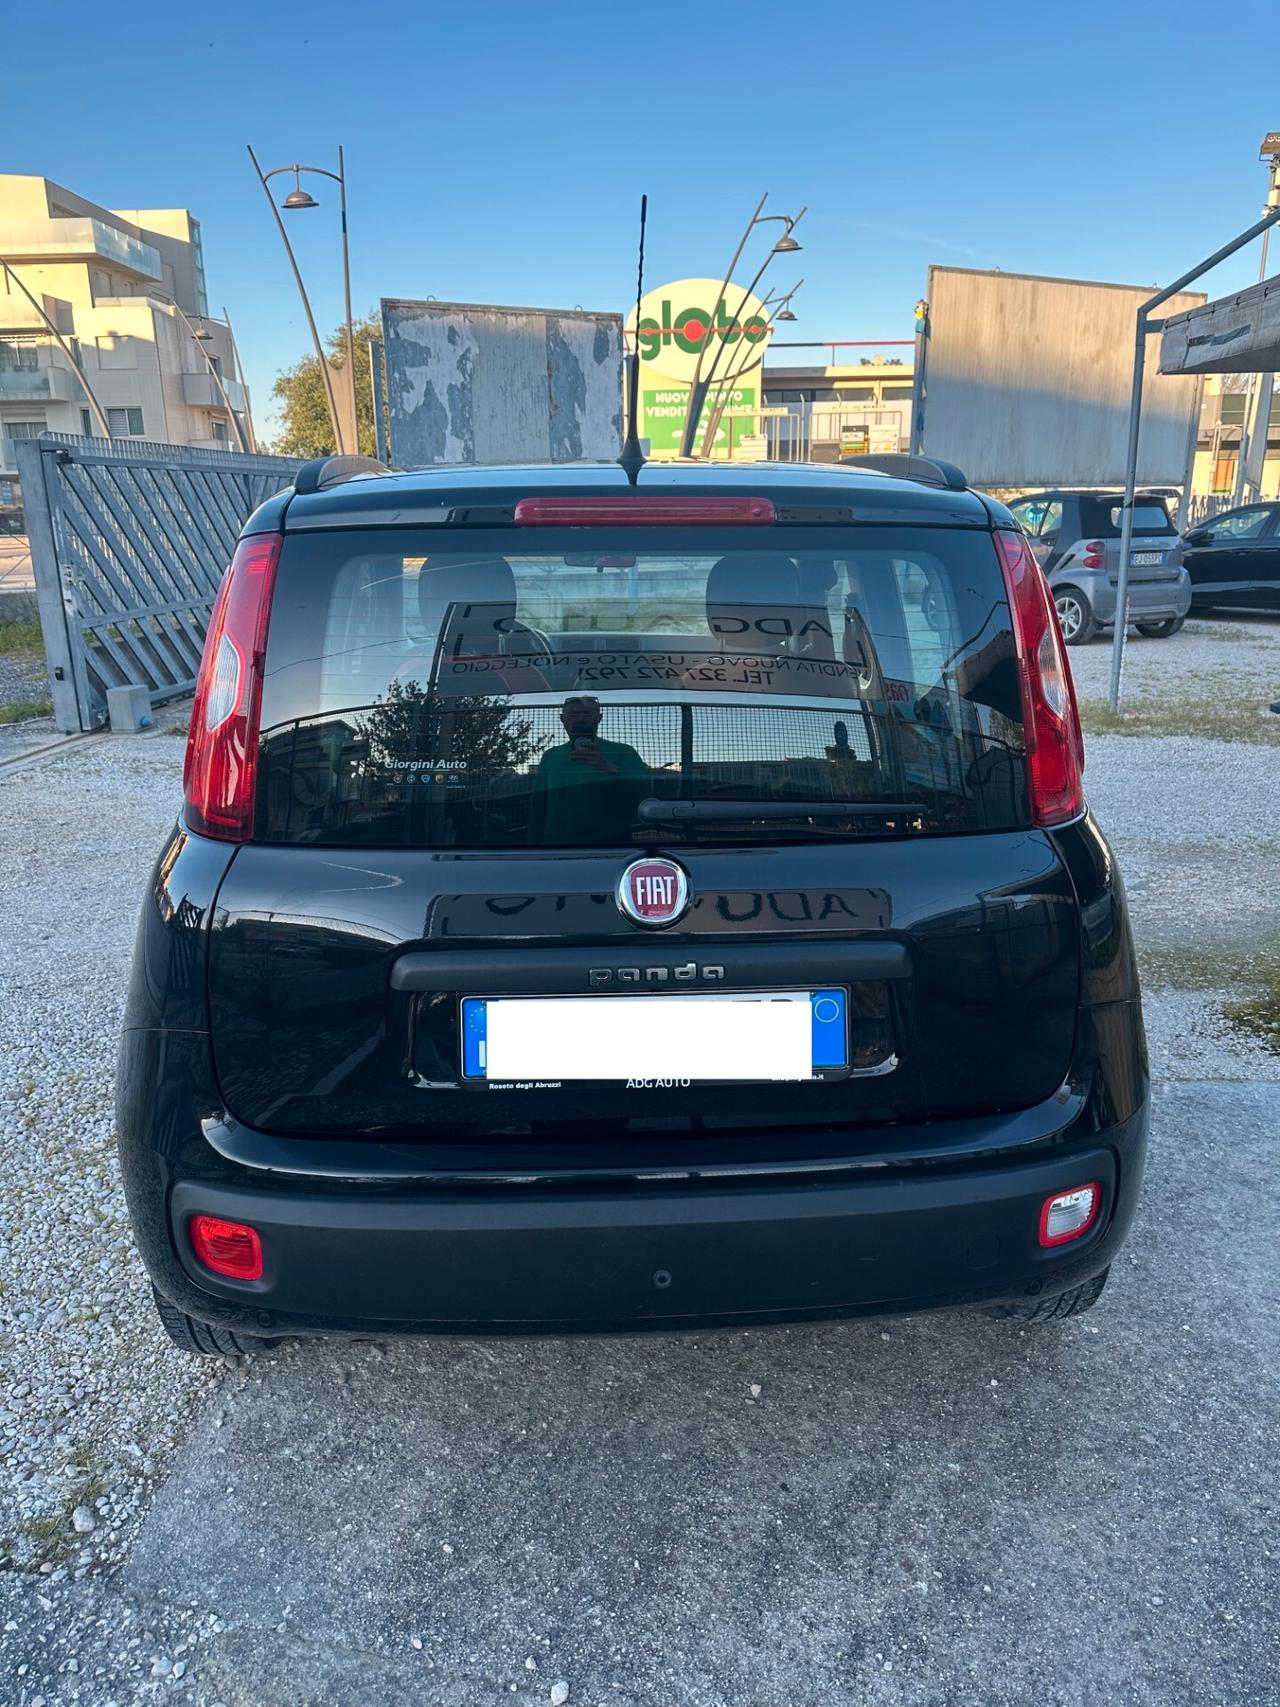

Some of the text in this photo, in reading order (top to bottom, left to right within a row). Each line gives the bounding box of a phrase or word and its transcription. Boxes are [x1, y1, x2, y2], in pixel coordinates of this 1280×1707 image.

[638, 299, 767, 361] globo
[655, 391, 690, 403] NUOV
[645, 406, 688, 417] VENDIT
[384, 759, 467, 771] Giorgini Auto
[636, 875, 674, 906] FIAT
[588, 963, 725, 986] panda
[489, 1076, 691, 1090] Roseto degli Abruzzi ADG AUTO
